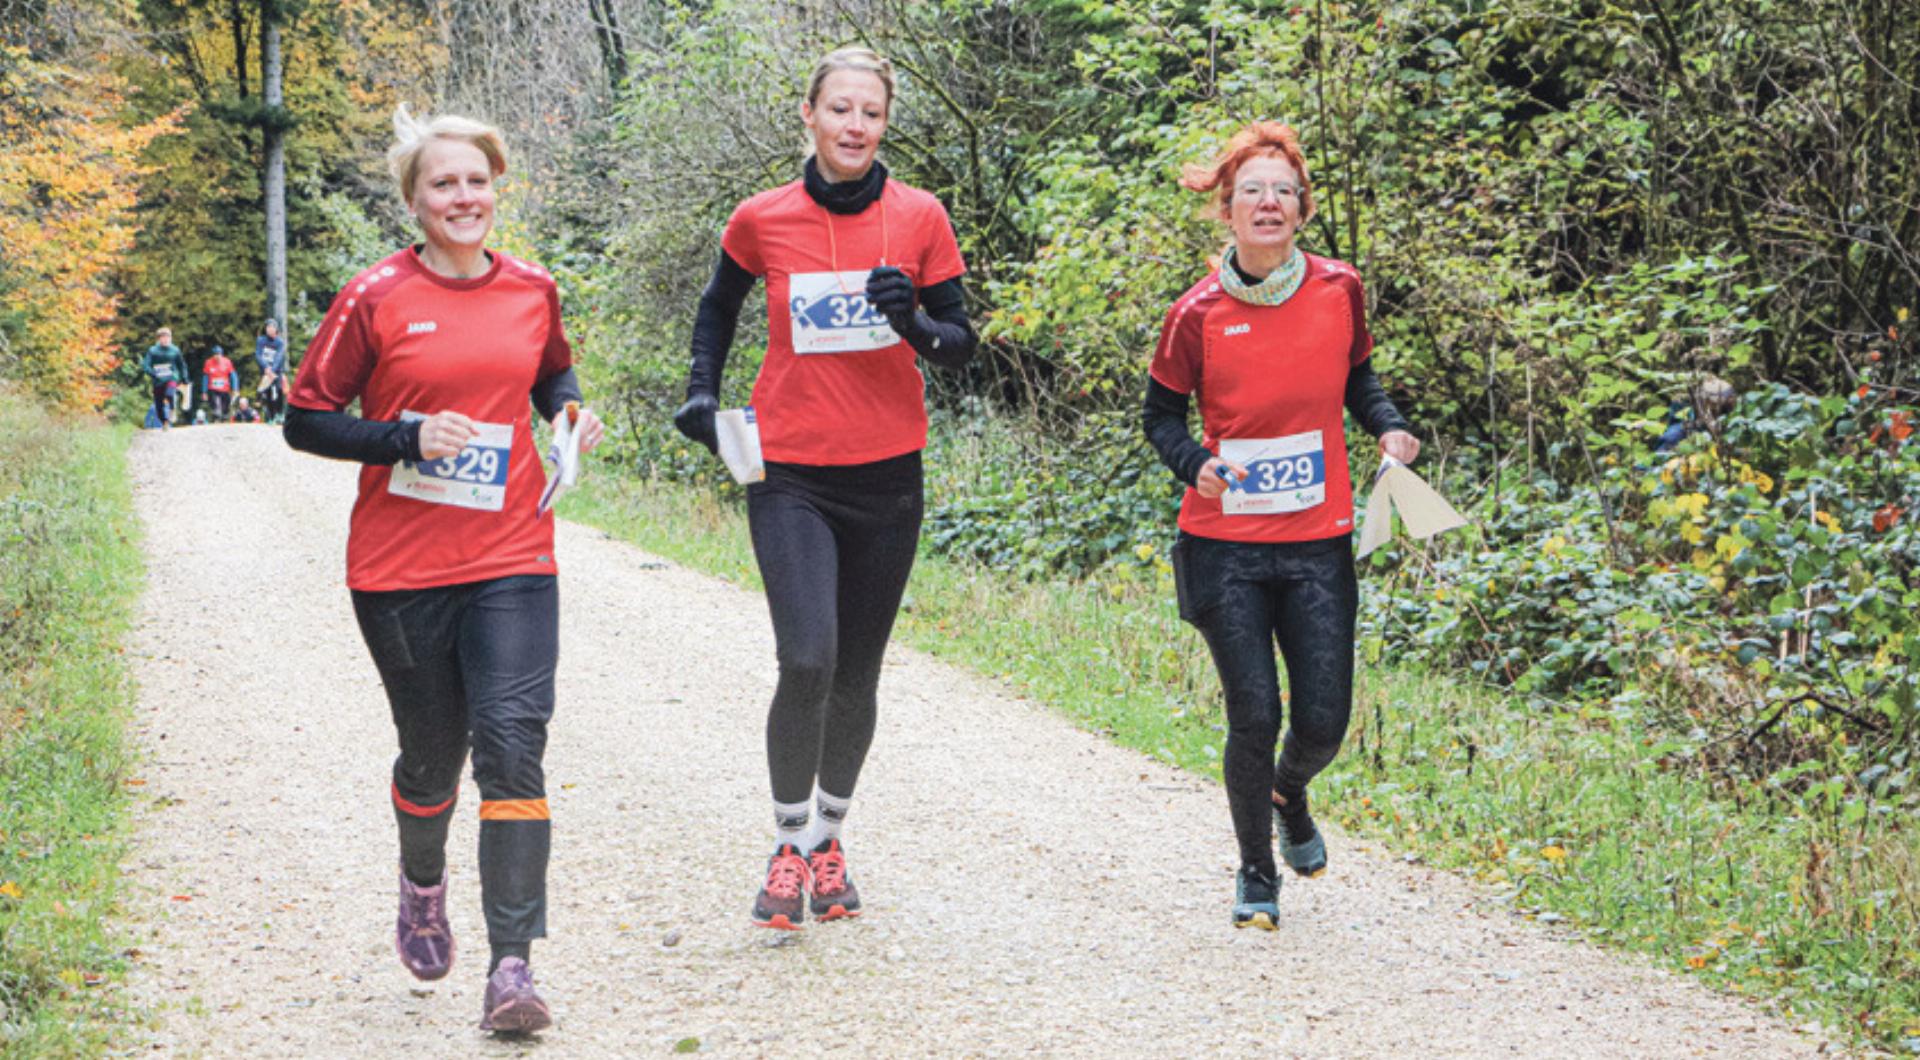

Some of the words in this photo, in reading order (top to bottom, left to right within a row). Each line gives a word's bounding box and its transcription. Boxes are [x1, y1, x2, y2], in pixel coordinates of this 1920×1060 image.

[406, 320, 437, 332] JAKO
[435, 447, 499, 483] 329
[1256, 456, 1314, 492] 329
